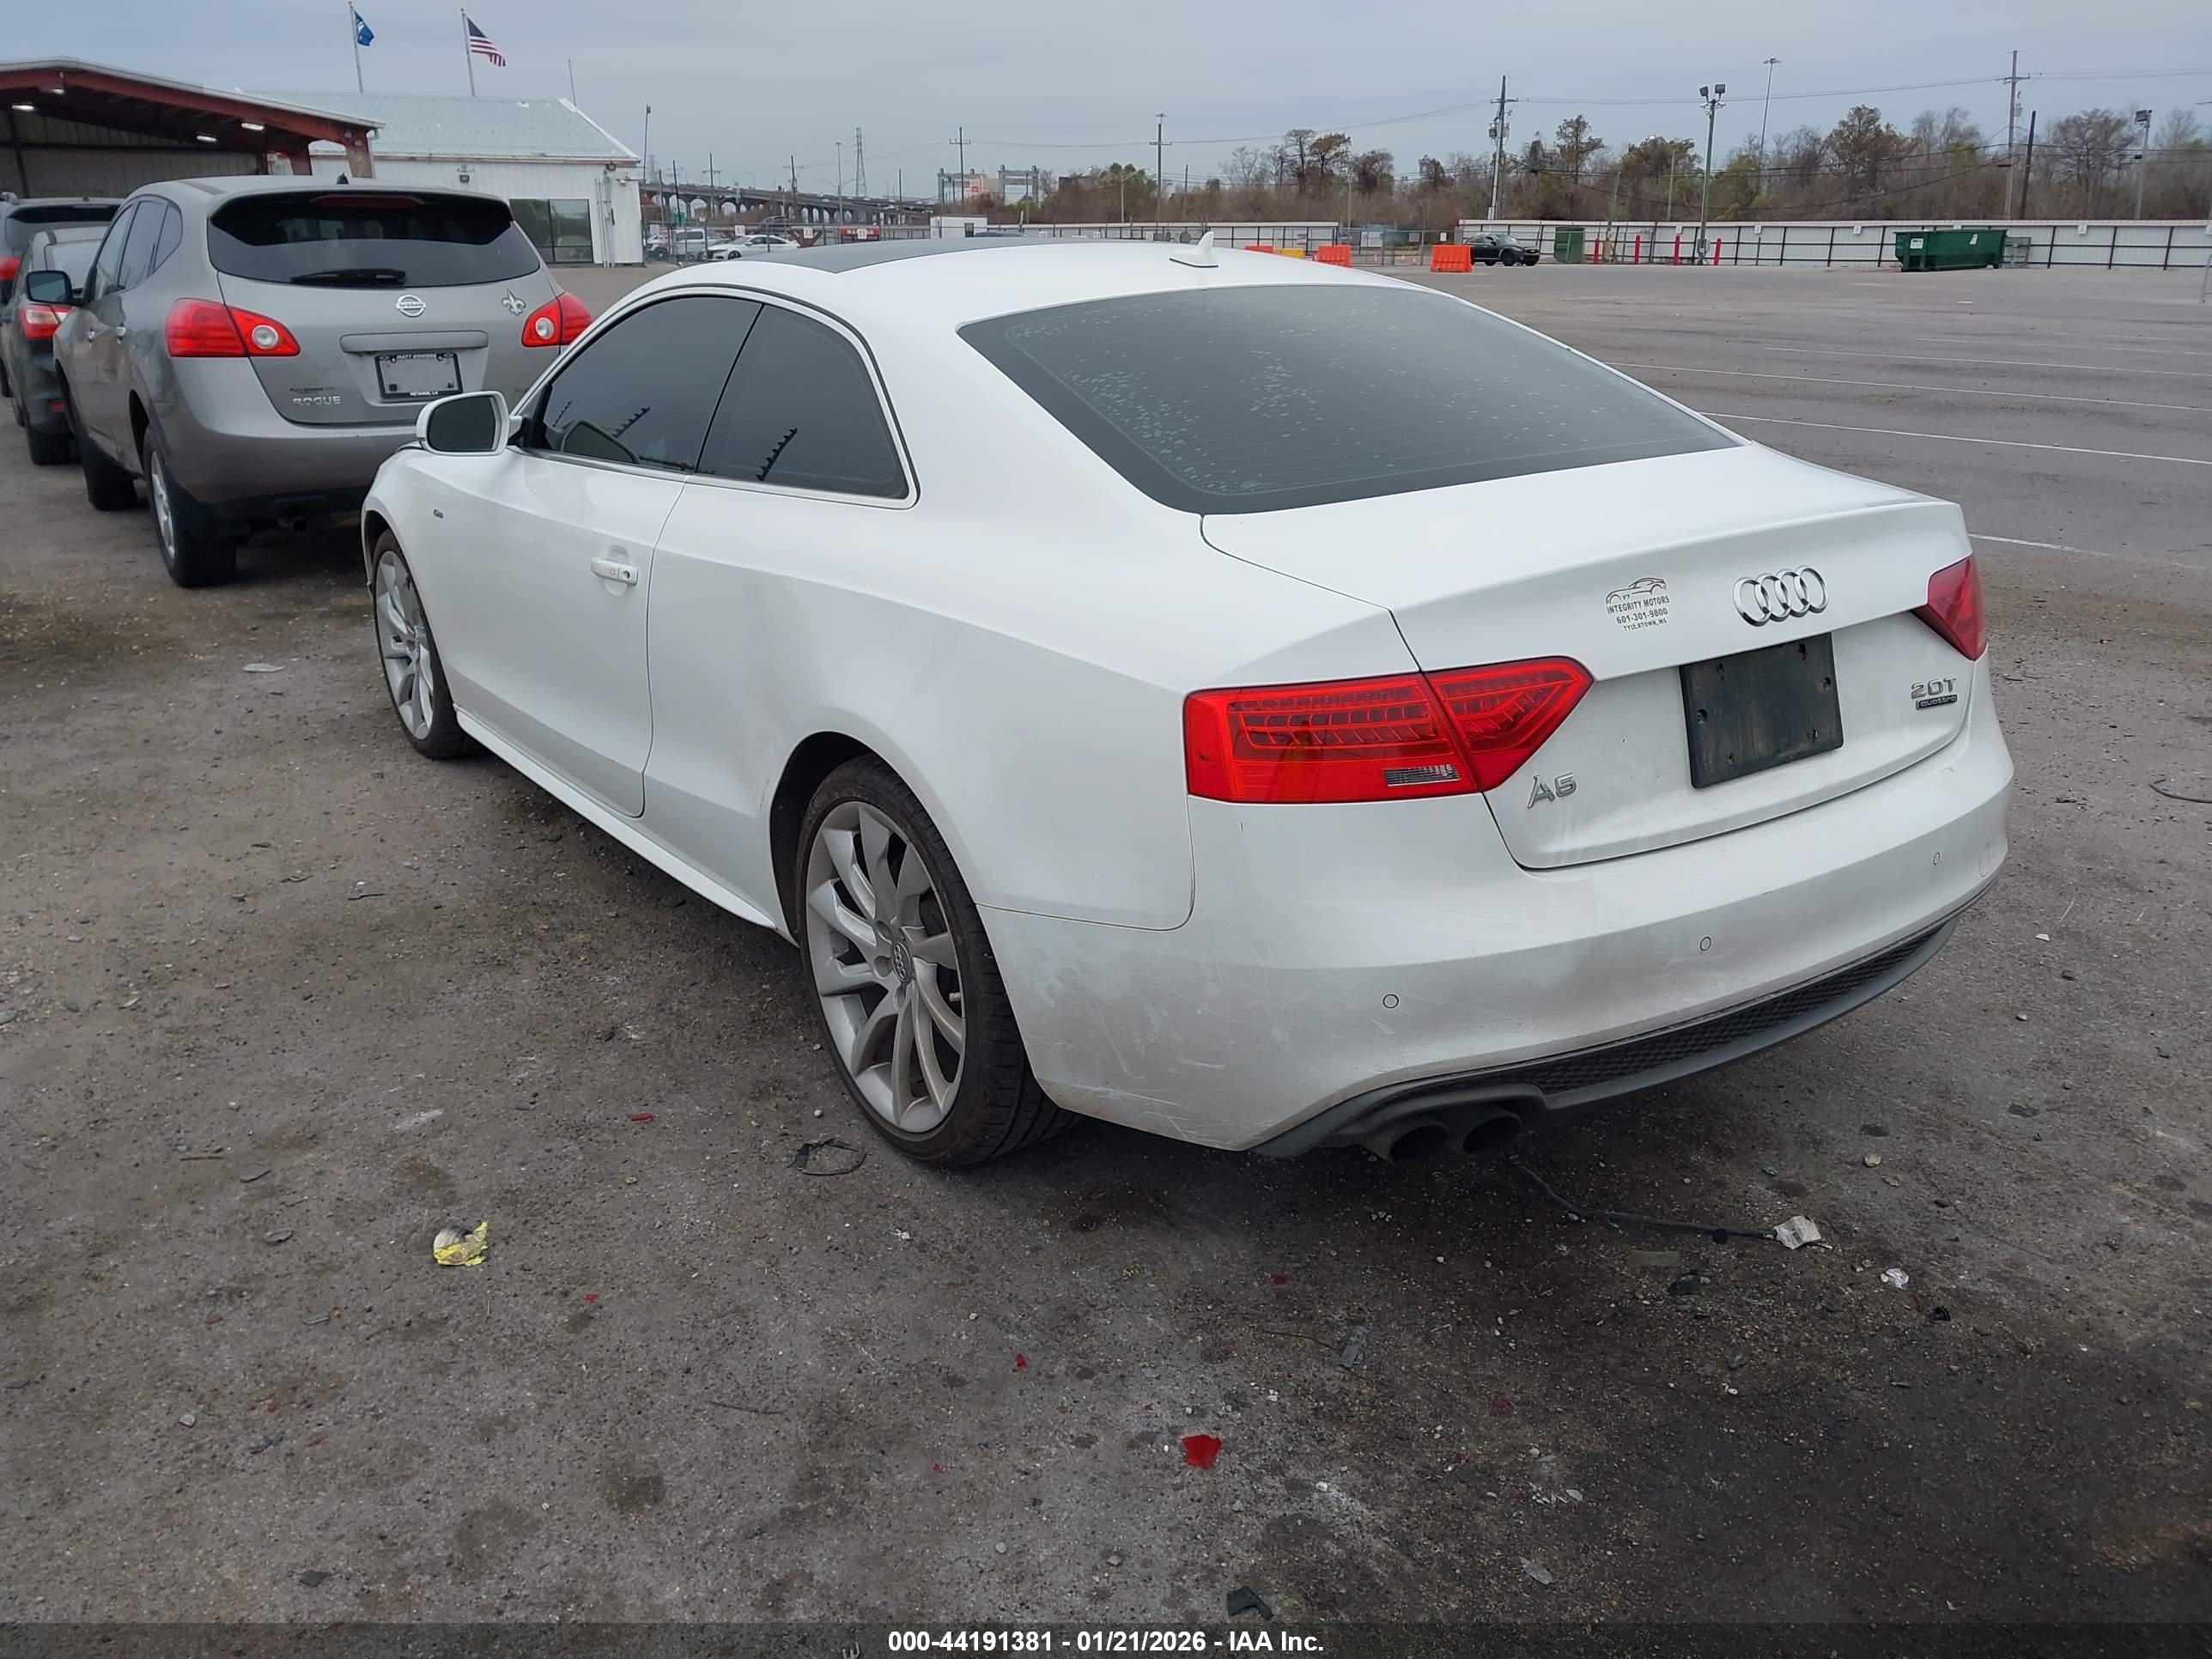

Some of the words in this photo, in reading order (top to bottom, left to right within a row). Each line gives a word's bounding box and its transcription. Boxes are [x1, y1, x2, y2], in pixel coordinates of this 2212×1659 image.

[293, 395, 341, 405] ROGUE
[1607, 599, 1642, 615] INTEGRITY
[1643, 595, 1670, 607] MOTORS
[1616, 607, 1668, 624] 601-301-9800
[1623, 619, 1659, 631] TYLERTOWN,
[1919, 696, 1957, 708] quattro
[1528, 772, 1577, 809] A5
